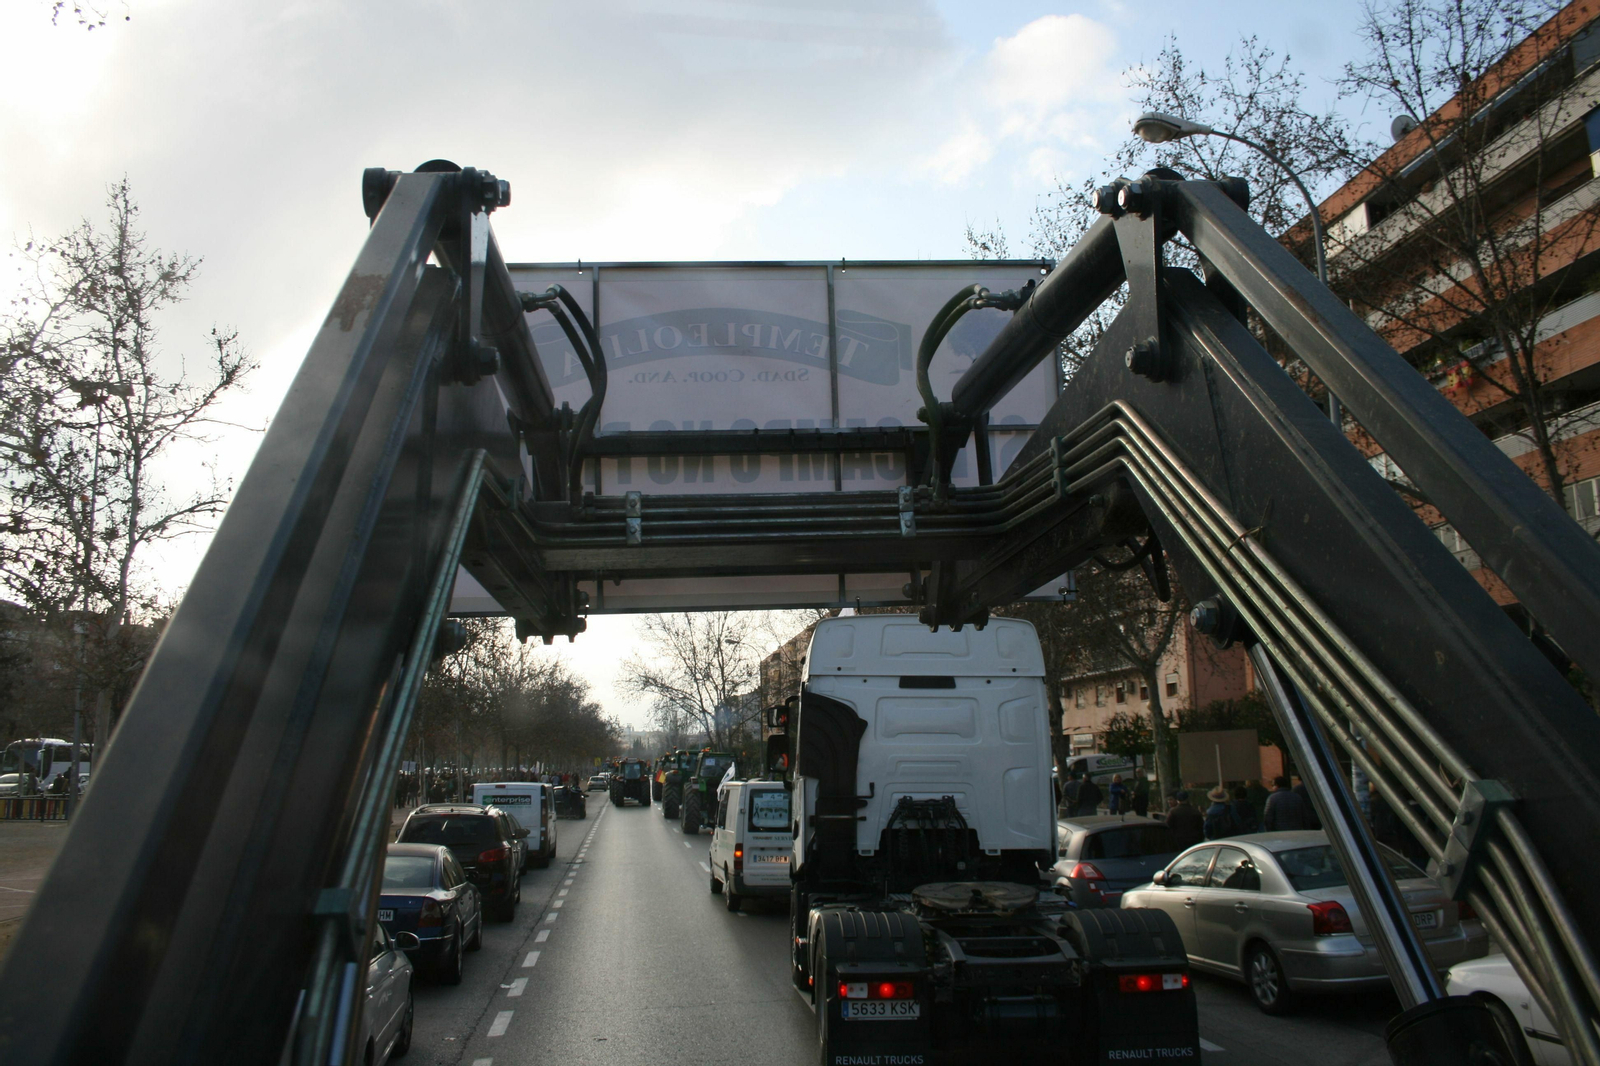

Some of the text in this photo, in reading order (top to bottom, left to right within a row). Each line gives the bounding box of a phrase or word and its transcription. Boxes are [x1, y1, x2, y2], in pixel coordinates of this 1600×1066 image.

[485, 796, 531, 804] enterprise
[852, 1001, 916, 1015] 5633 KSK
[1108, 1046, 1194, 1060] RENAULT TRUCKS
[835, 1054, 924, 1065] RENAULT TRUCKS
